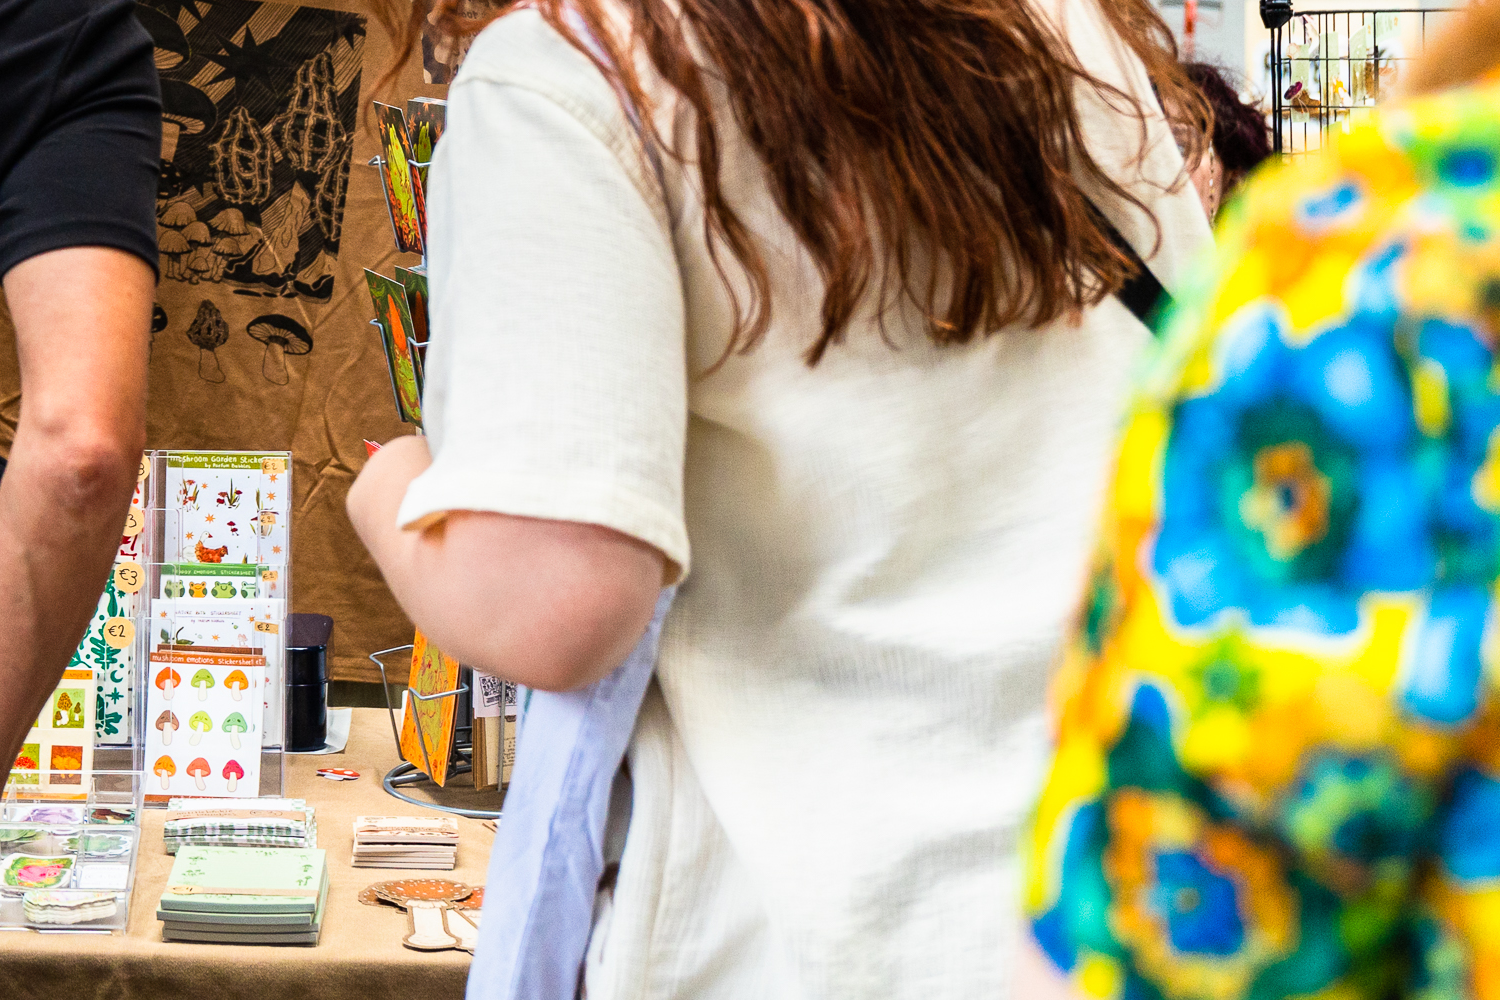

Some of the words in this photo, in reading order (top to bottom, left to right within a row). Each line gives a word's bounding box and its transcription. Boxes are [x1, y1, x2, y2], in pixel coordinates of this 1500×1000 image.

[124, 513, 137, 528] 3
[118, 568, 138, 586] €3
[107, 624, 126, 638] €2
